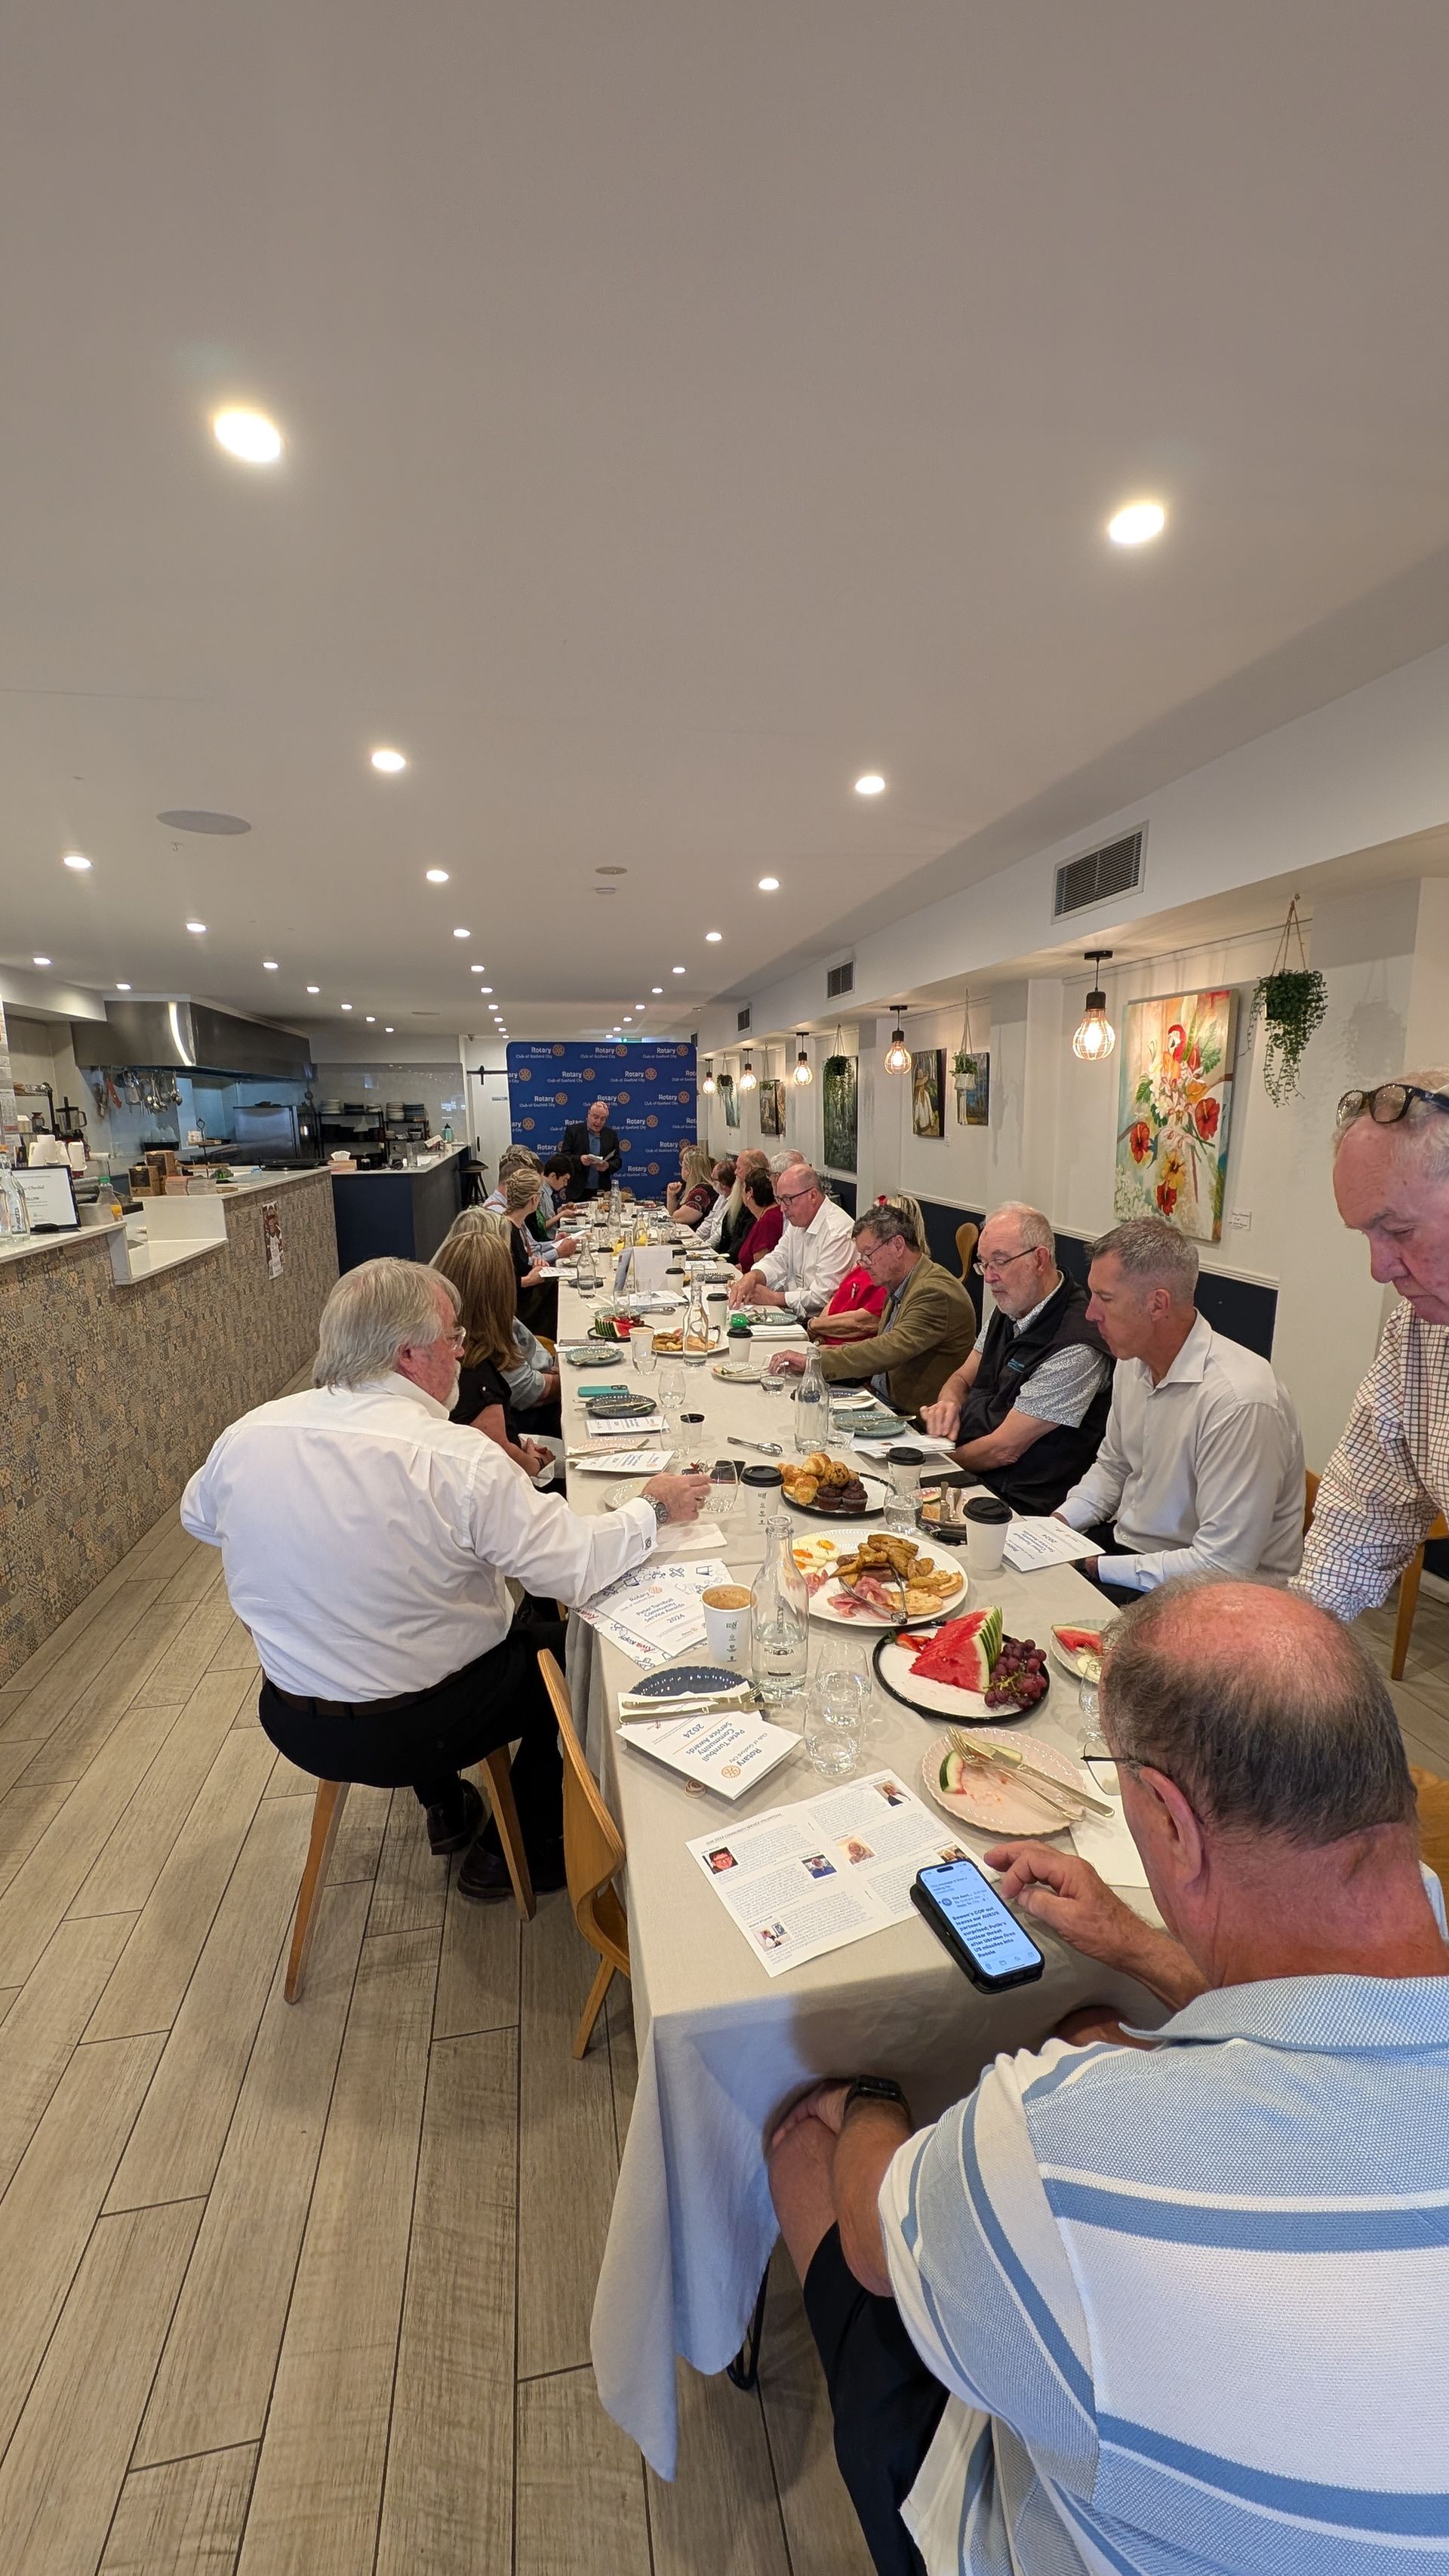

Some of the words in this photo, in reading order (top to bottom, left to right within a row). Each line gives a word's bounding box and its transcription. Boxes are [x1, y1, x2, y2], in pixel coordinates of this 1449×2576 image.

[683, 1724, 704, 1738] 2024
[708, 1722, 732, 1738] Service
[727, 1729, 745, 1742] Peter
[686, 1737, 710, 1754] Awards
[697, 1728, 734, 1755] Community
[702, 1740, 731, 1762] Turnbull
[737, 1747, 762, 1766] Rotary
[960, 1922, 982, 1931] partners
